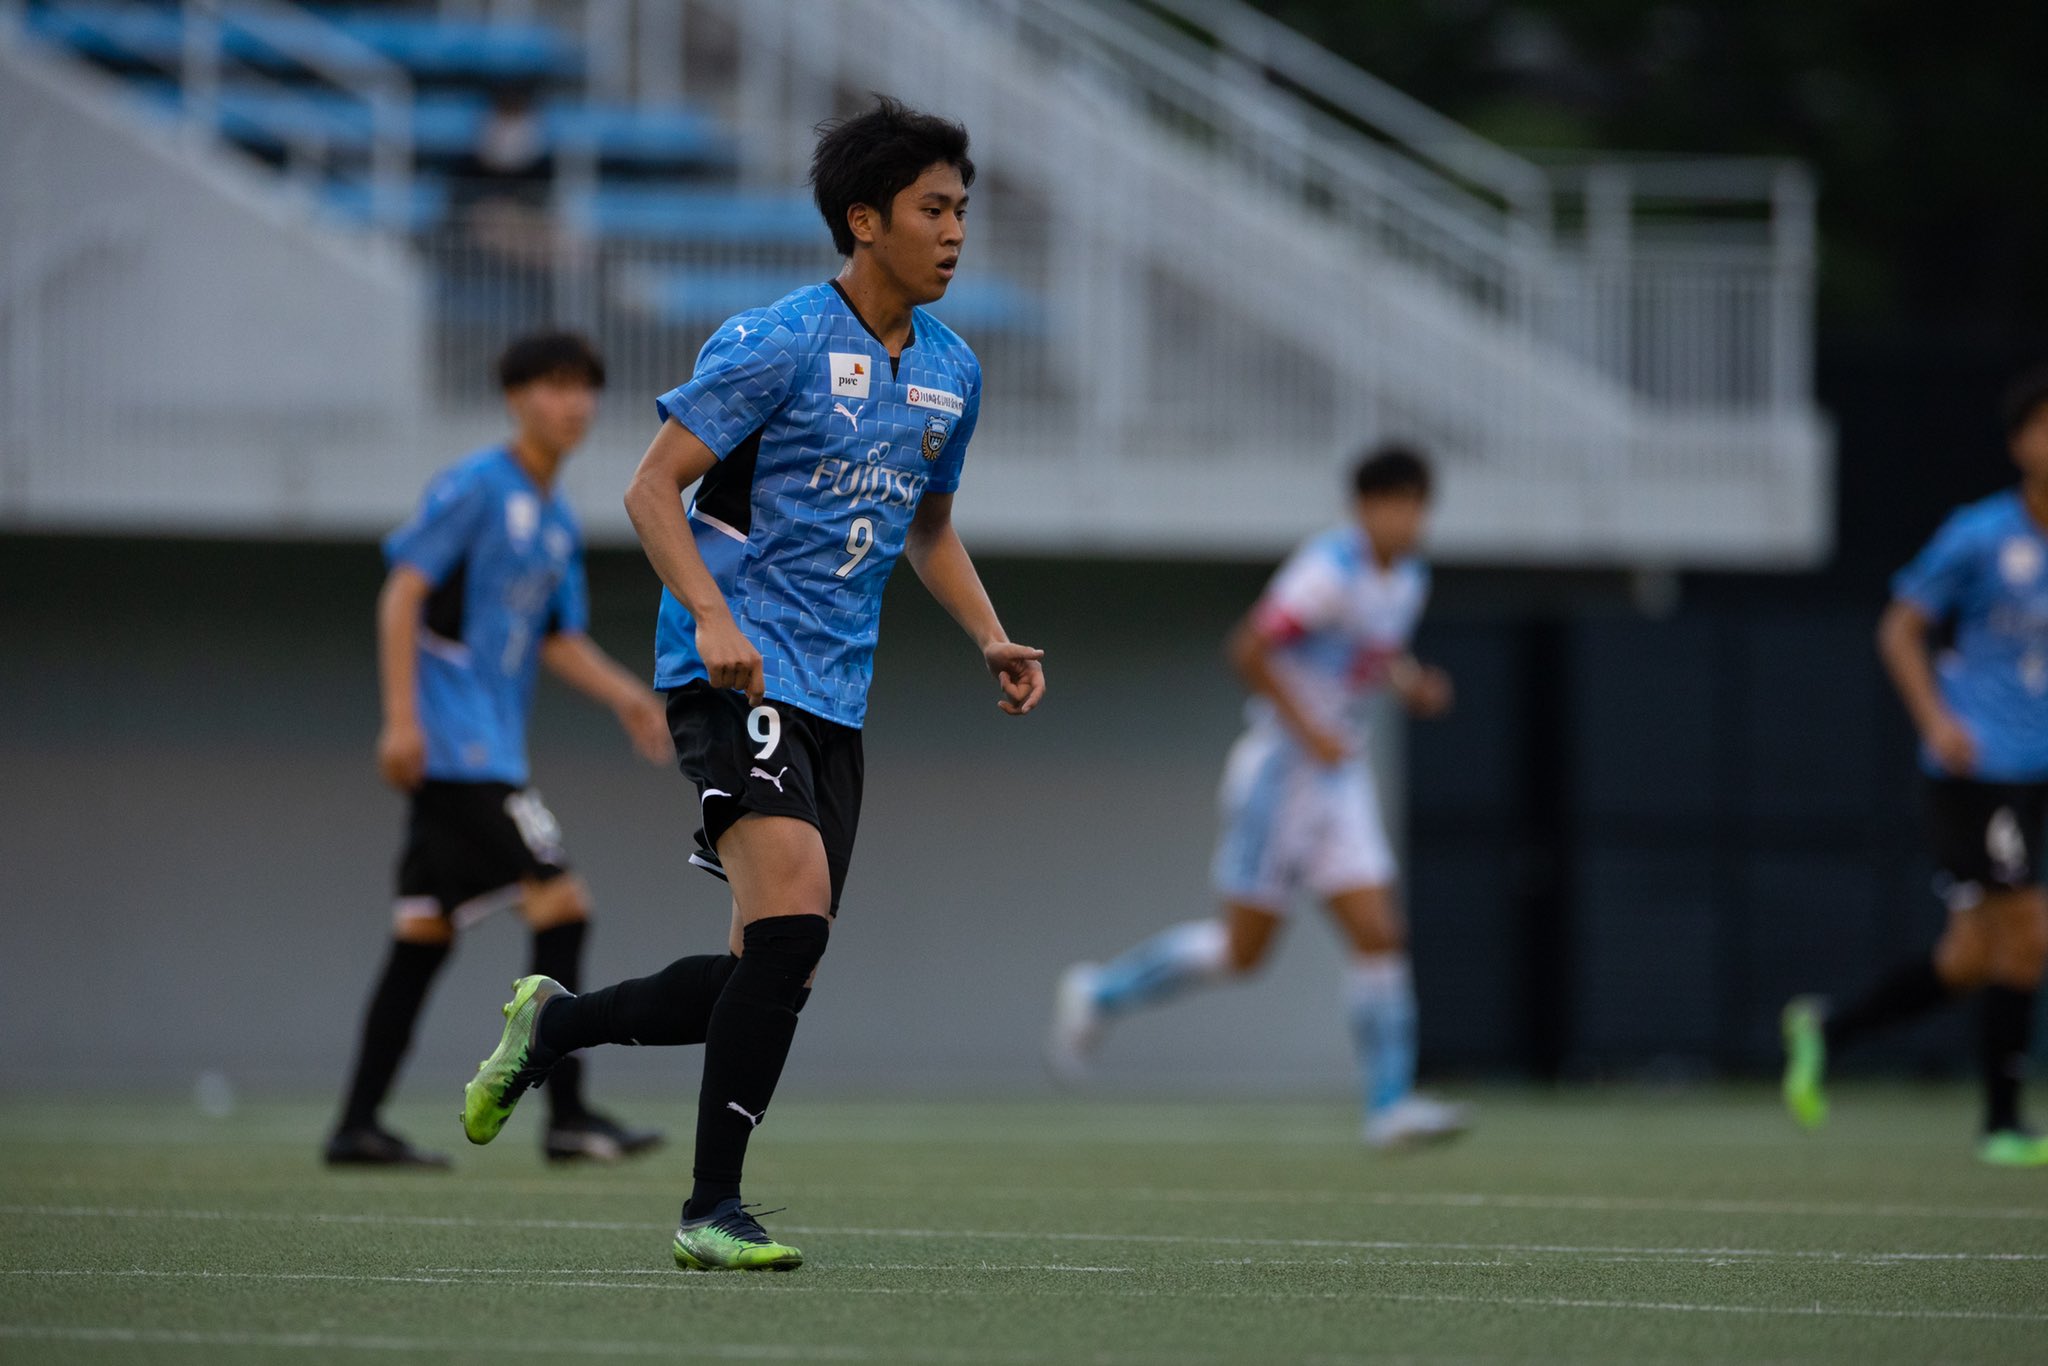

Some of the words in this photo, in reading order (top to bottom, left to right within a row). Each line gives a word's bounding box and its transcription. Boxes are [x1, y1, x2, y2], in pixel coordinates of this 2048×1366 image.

[838, 376, 859, 387] pwc
[809, 457, 929, 509] FUJITSU
[834, 516, 874, 578] 9
[747, 705, 781, 760] 9
